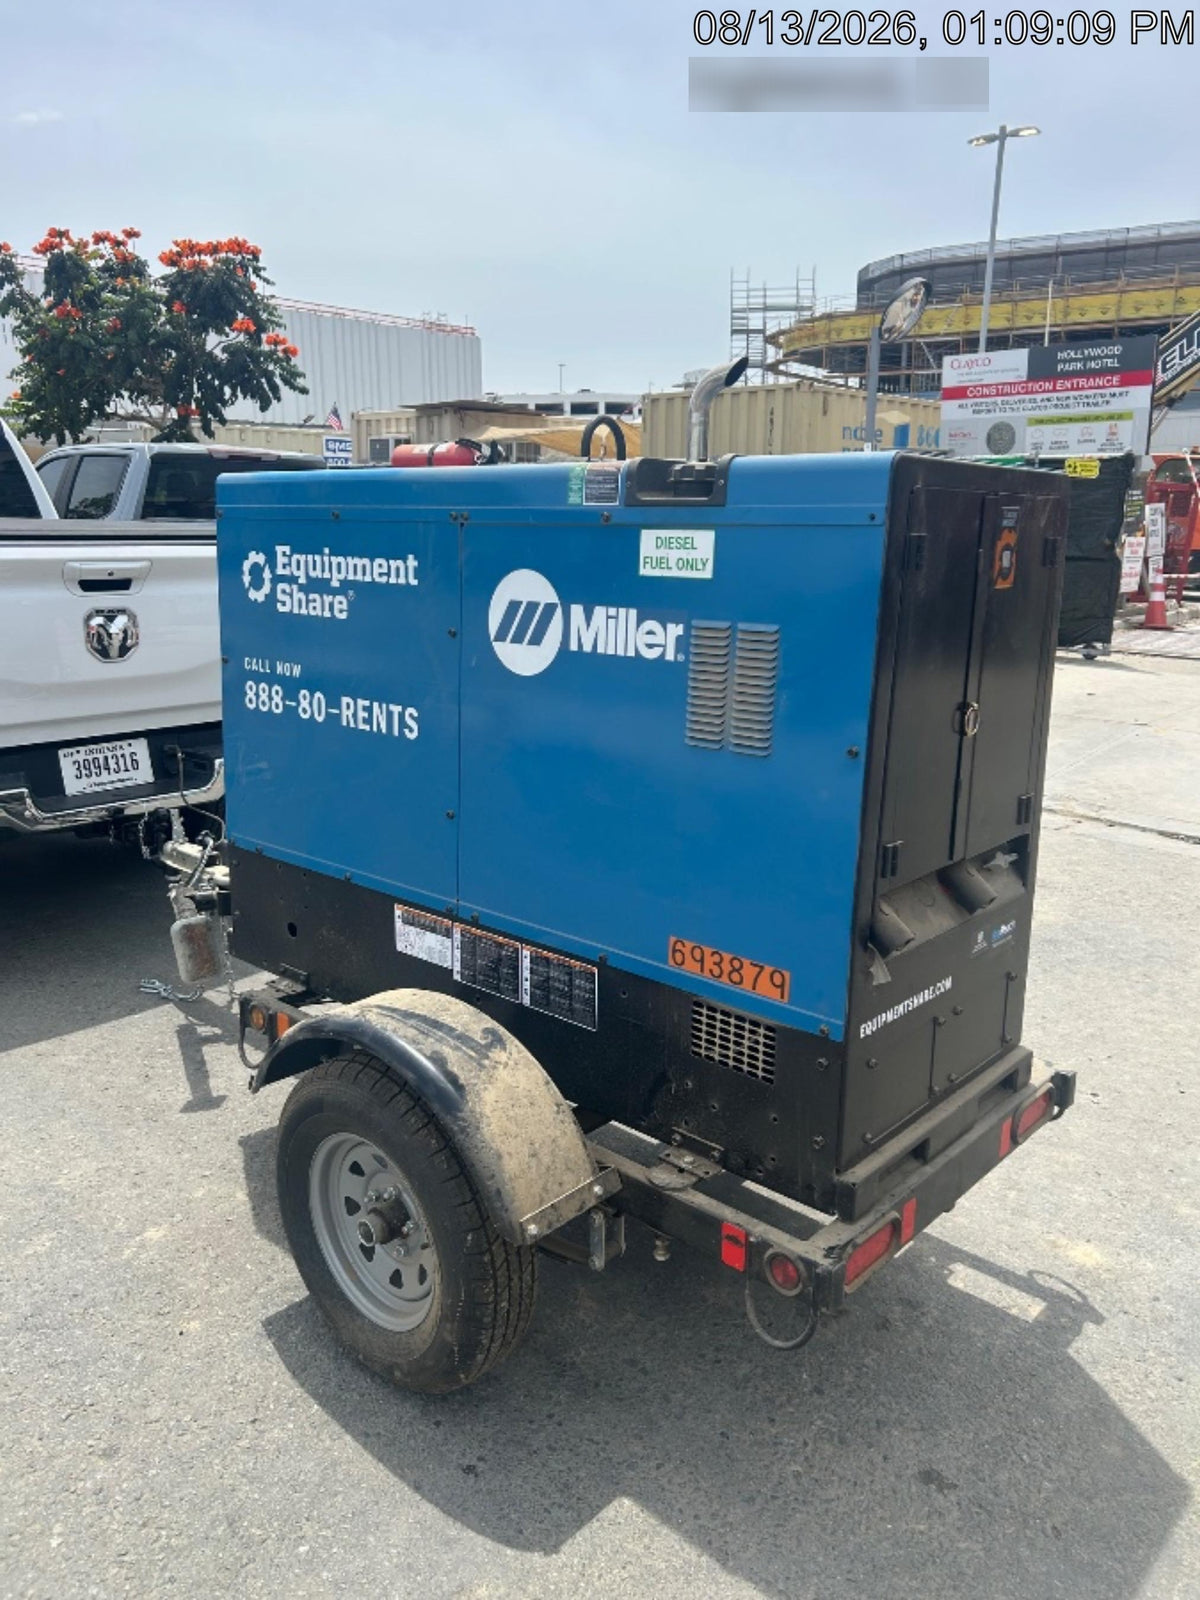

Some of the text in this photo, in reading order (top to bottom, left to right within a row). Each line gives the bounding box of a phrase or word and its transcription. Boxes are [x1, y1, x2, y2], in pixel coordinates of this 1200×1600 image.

[1057, 344, 1123, 360] HOLLYWOOD
[1057, 357, 1120, 372] PARK HOTEL
[966, 375, 1121, 397] CONSTRUCTION ENTRANCE
[655, 536, 698, 550] DIESEL
[275, 545, 418, 587] Equipment
[643, 556, 710, 571] FUEL ONLY
[569, 603, 684, 662] Miller
[244, 657, 302, 678] CALL NOW
[244, 680, 419, 740] 888-80-RENTS
[72, 751, 140, 780] 3994316
[671, 939, 786, 1000] 693879
[860, 975, 953, 1039] EQUIPMENTSHARE.COM
